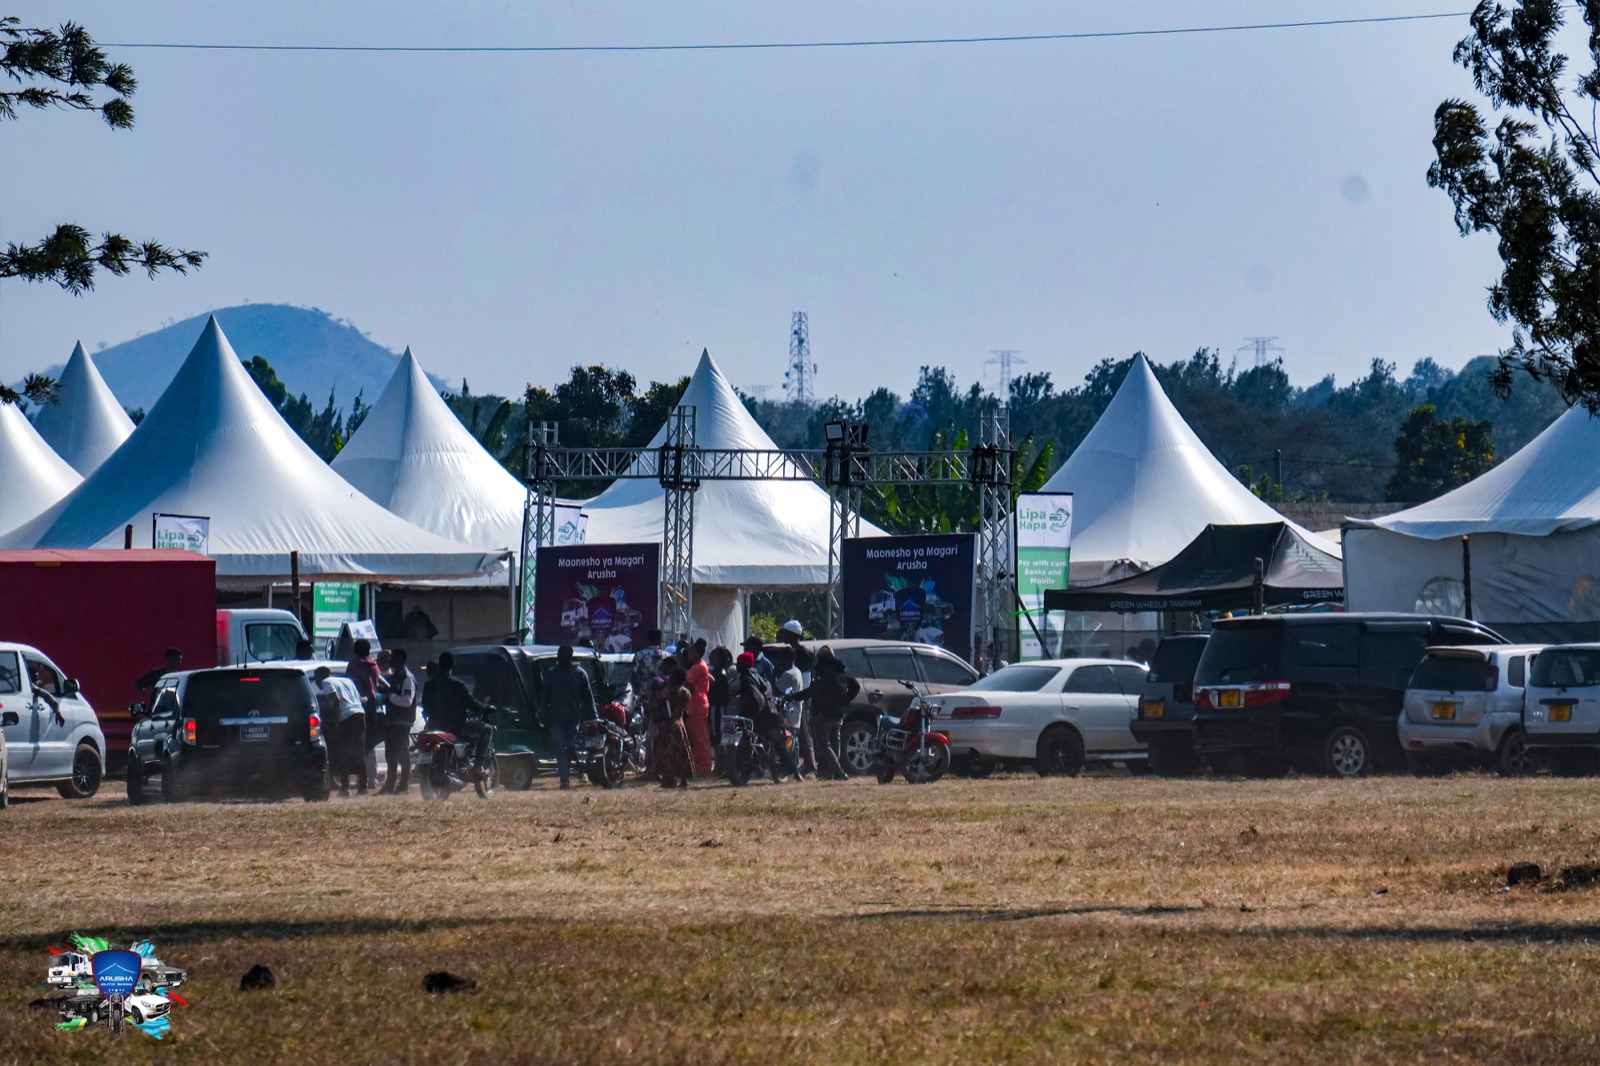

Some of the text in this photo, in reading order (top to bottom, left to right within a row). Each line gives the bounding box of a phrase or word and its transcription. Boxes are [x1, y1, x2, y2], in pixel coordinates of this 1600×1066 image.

[1019, 508, 1047, 522] Lipa
[1019, 520, 1047, 532] Hapa
[157, 529, 185, 542] Lipa
[157, 540, 185, 549] Hapa
[866, 544, 958, 560] Maonesho ya Magari
[558, 554, 644, 568] Maonesho ya Magari
[896, 559, 928, 570] Arusha
[1019, 560, 1031, 568] Pay
[587, 568, 617, 579] Arusha
[1030, 577, 1056, 585] Mobile
[1303, 590, 1333, 599] GREEN
[1110, 599, 1202, 609] GREEN WHEELS TANZANIA
